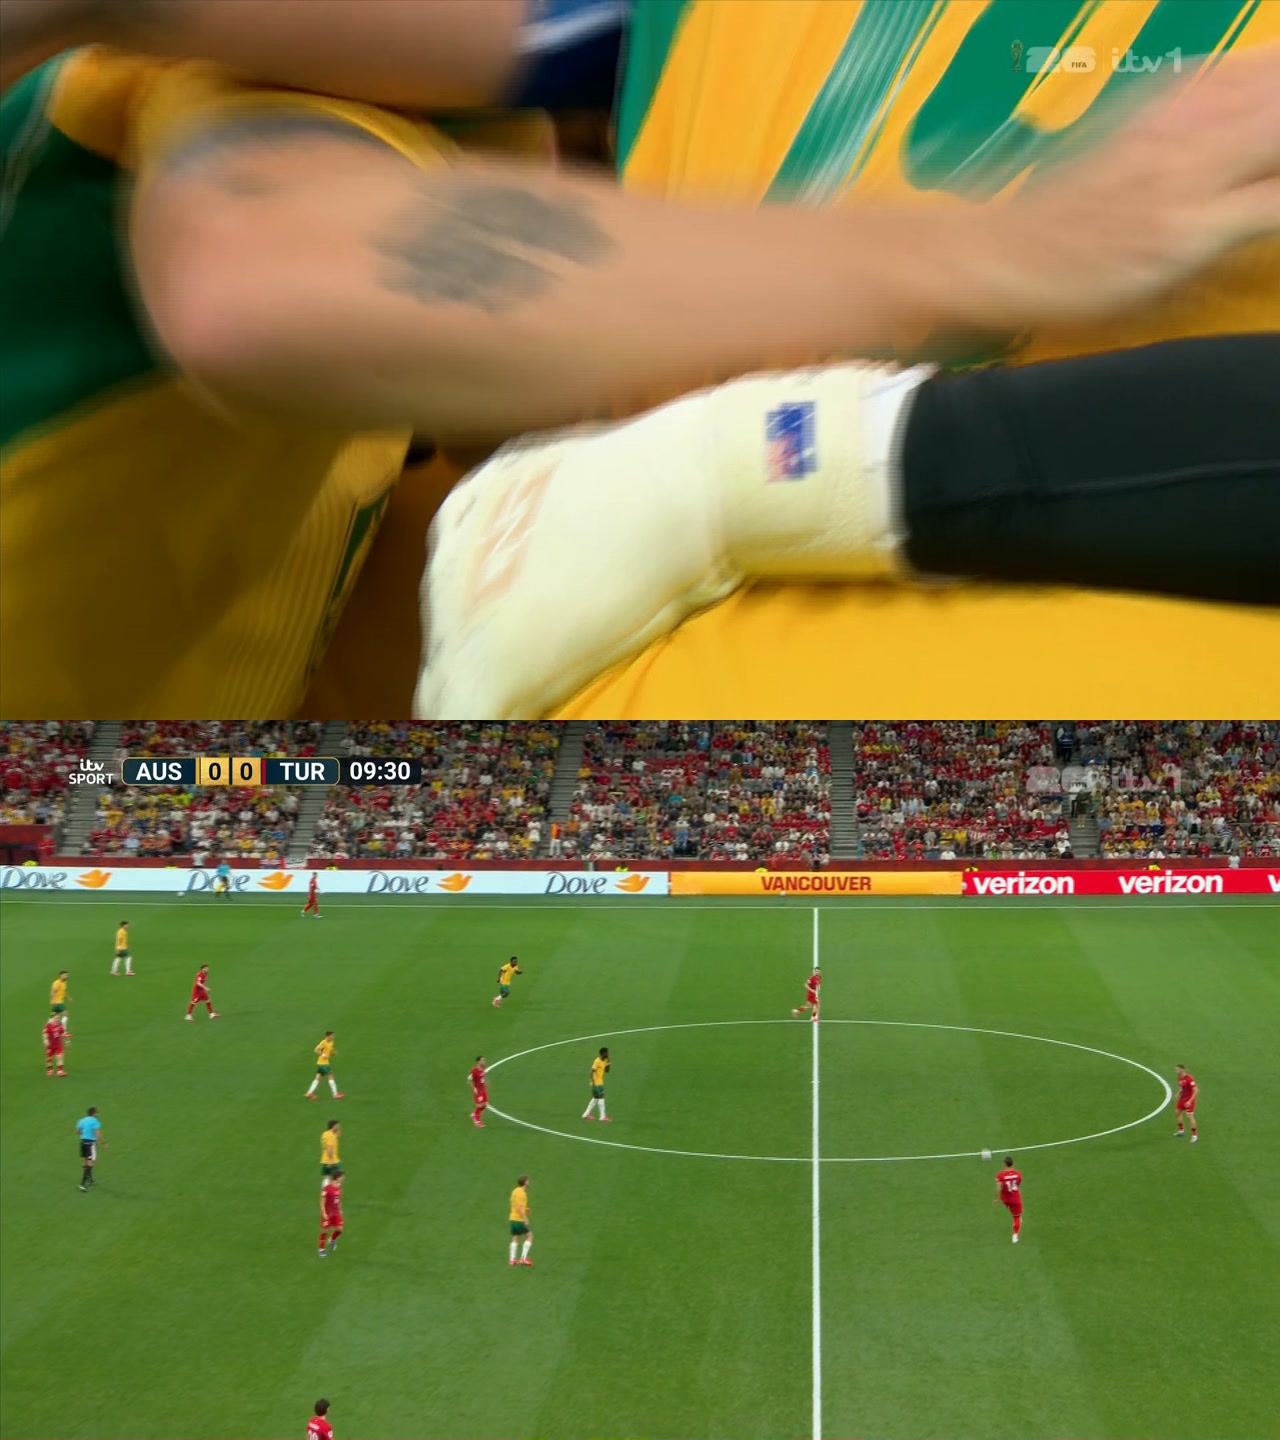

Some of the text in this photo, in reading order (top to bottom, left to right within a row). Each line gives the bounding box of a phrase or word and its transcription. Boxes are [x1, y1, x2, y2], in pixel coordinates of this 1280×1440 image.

[1, 866, 68, 889] Dove
[366, 870, 429, 893] Dove
[544, 871, 608, 894] Dove
[761, 876, 872, 891] VANCOUVER
[973, 871, 1074, 894] verizon
[1118, 870, 1223, 893] verizon
